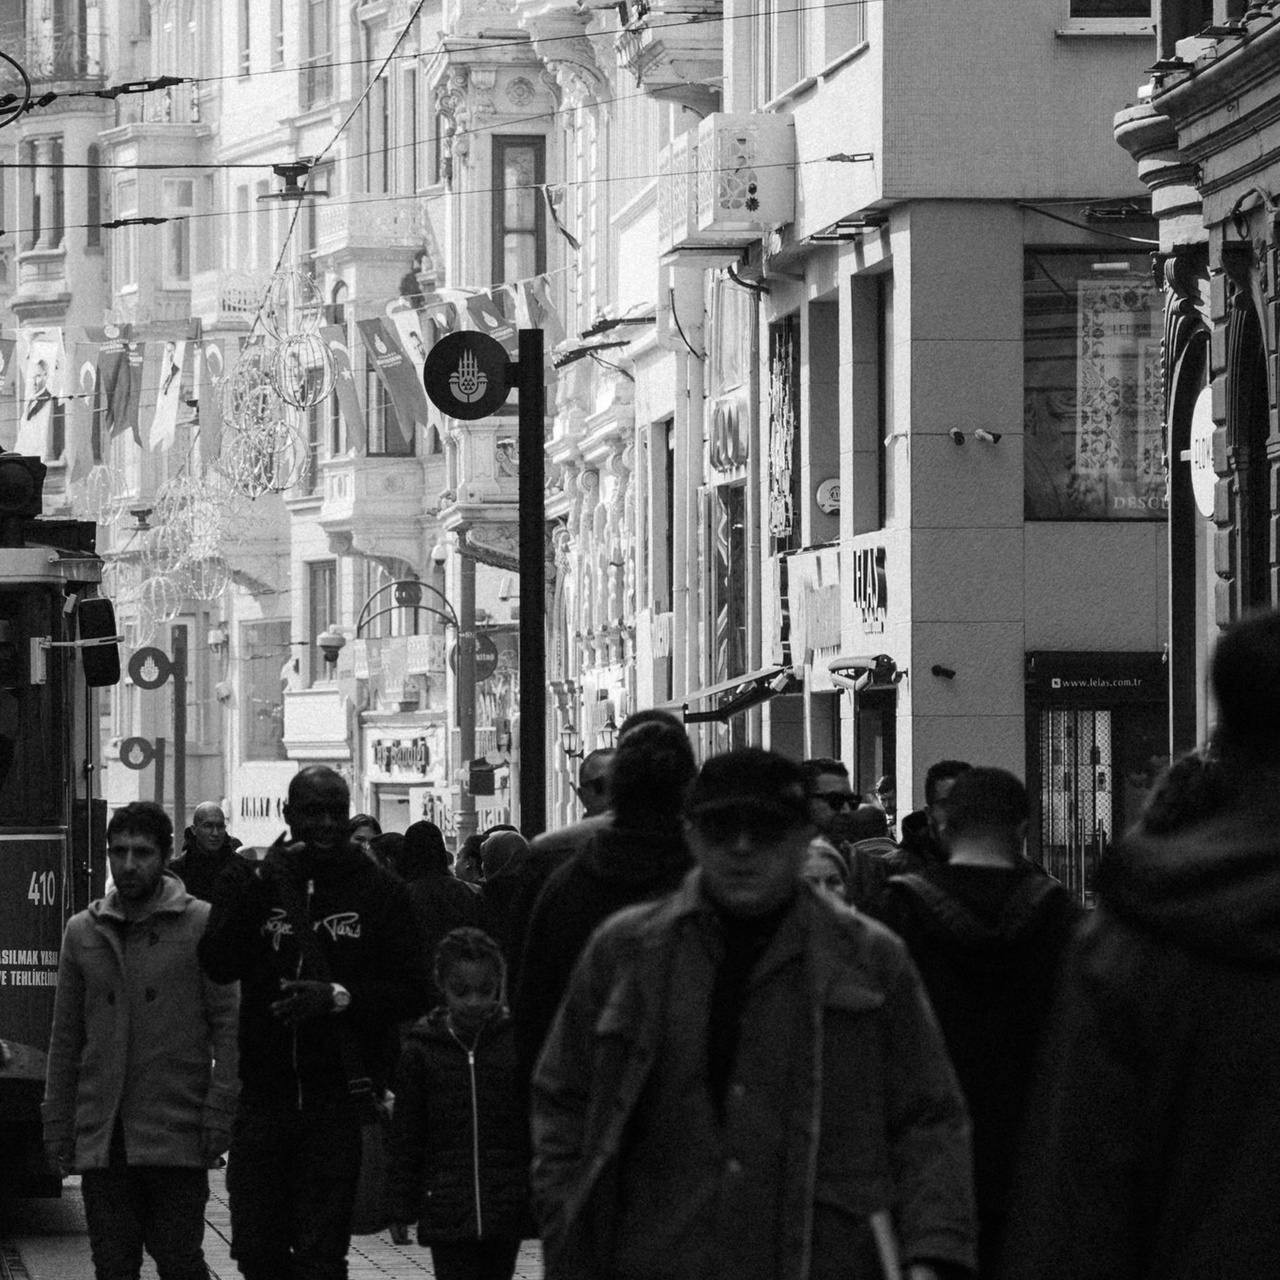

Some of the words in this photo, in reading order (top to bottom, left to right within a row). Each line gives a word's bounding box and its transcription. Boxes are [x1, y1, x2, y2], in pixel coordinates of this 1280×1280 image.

[1062, 677, 1142, 687] www.lelas.com.tr
[27, 870, 56, 906] 410
[323, 911, 361, 942] Paris
